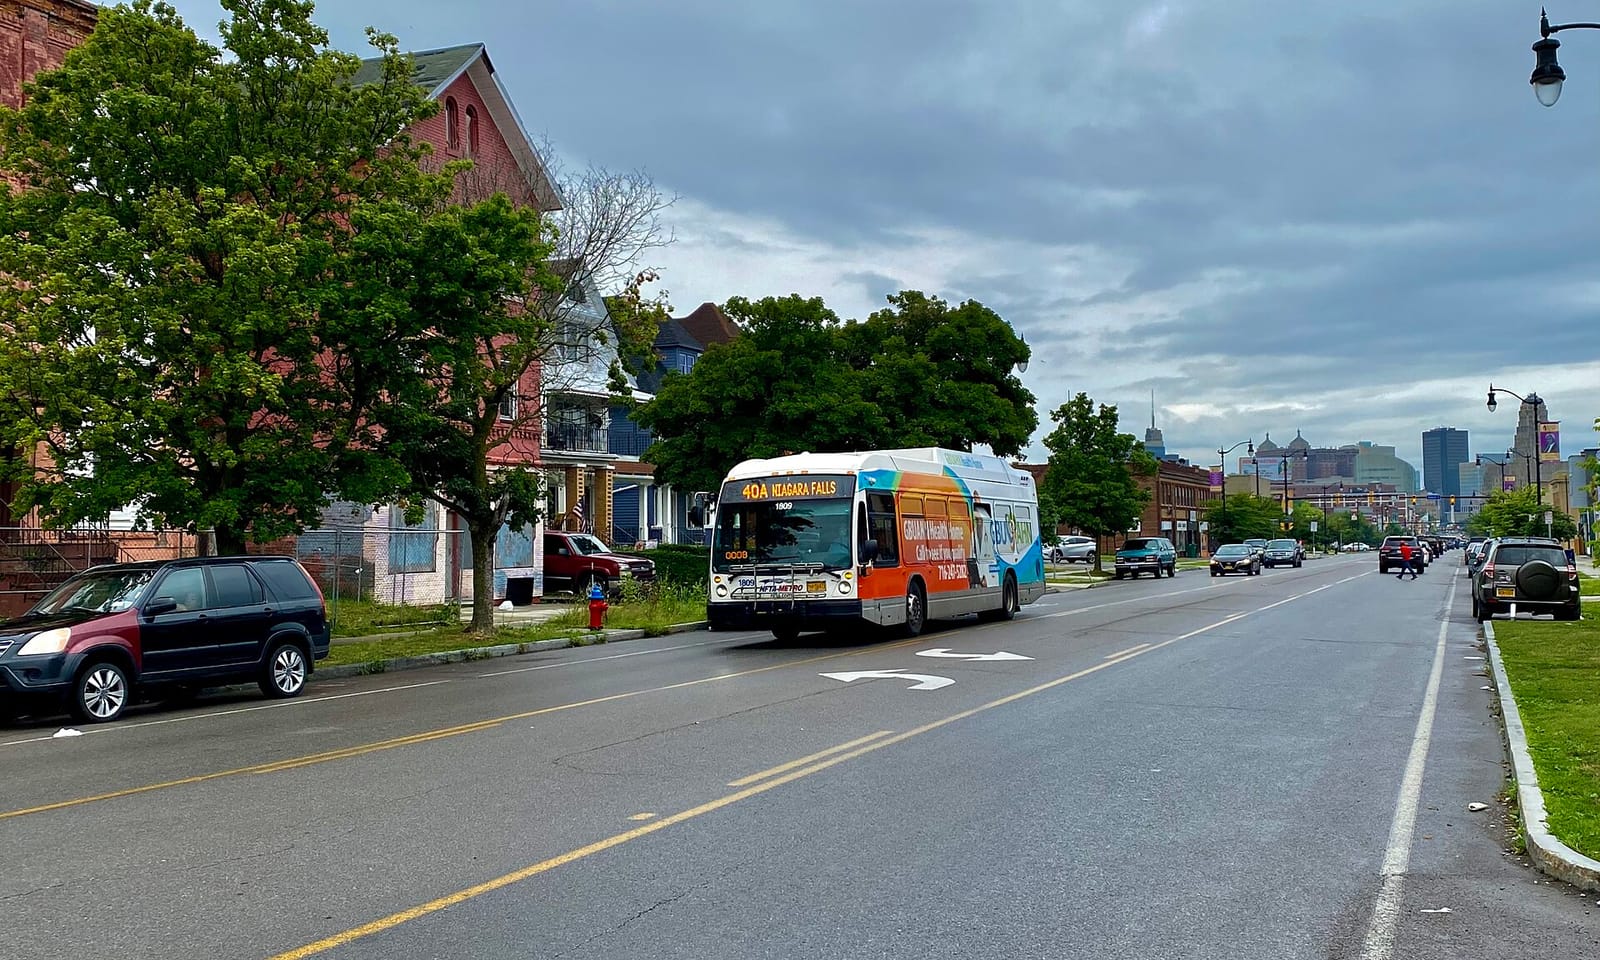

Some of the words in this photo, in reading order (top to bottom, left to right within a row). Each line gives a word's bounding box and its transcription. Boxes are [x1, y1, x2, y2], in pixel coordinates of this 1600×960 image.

[742, 483, 769, 499] 40A
[771, 483, 809, 497] NIAGARA
[811, 480, 837, 496] FALLS
[775, 502, 793, 510] 1809
[738, 579, 755, 587] 1809
[759, 584, 804, 593] NFTA-METRO
